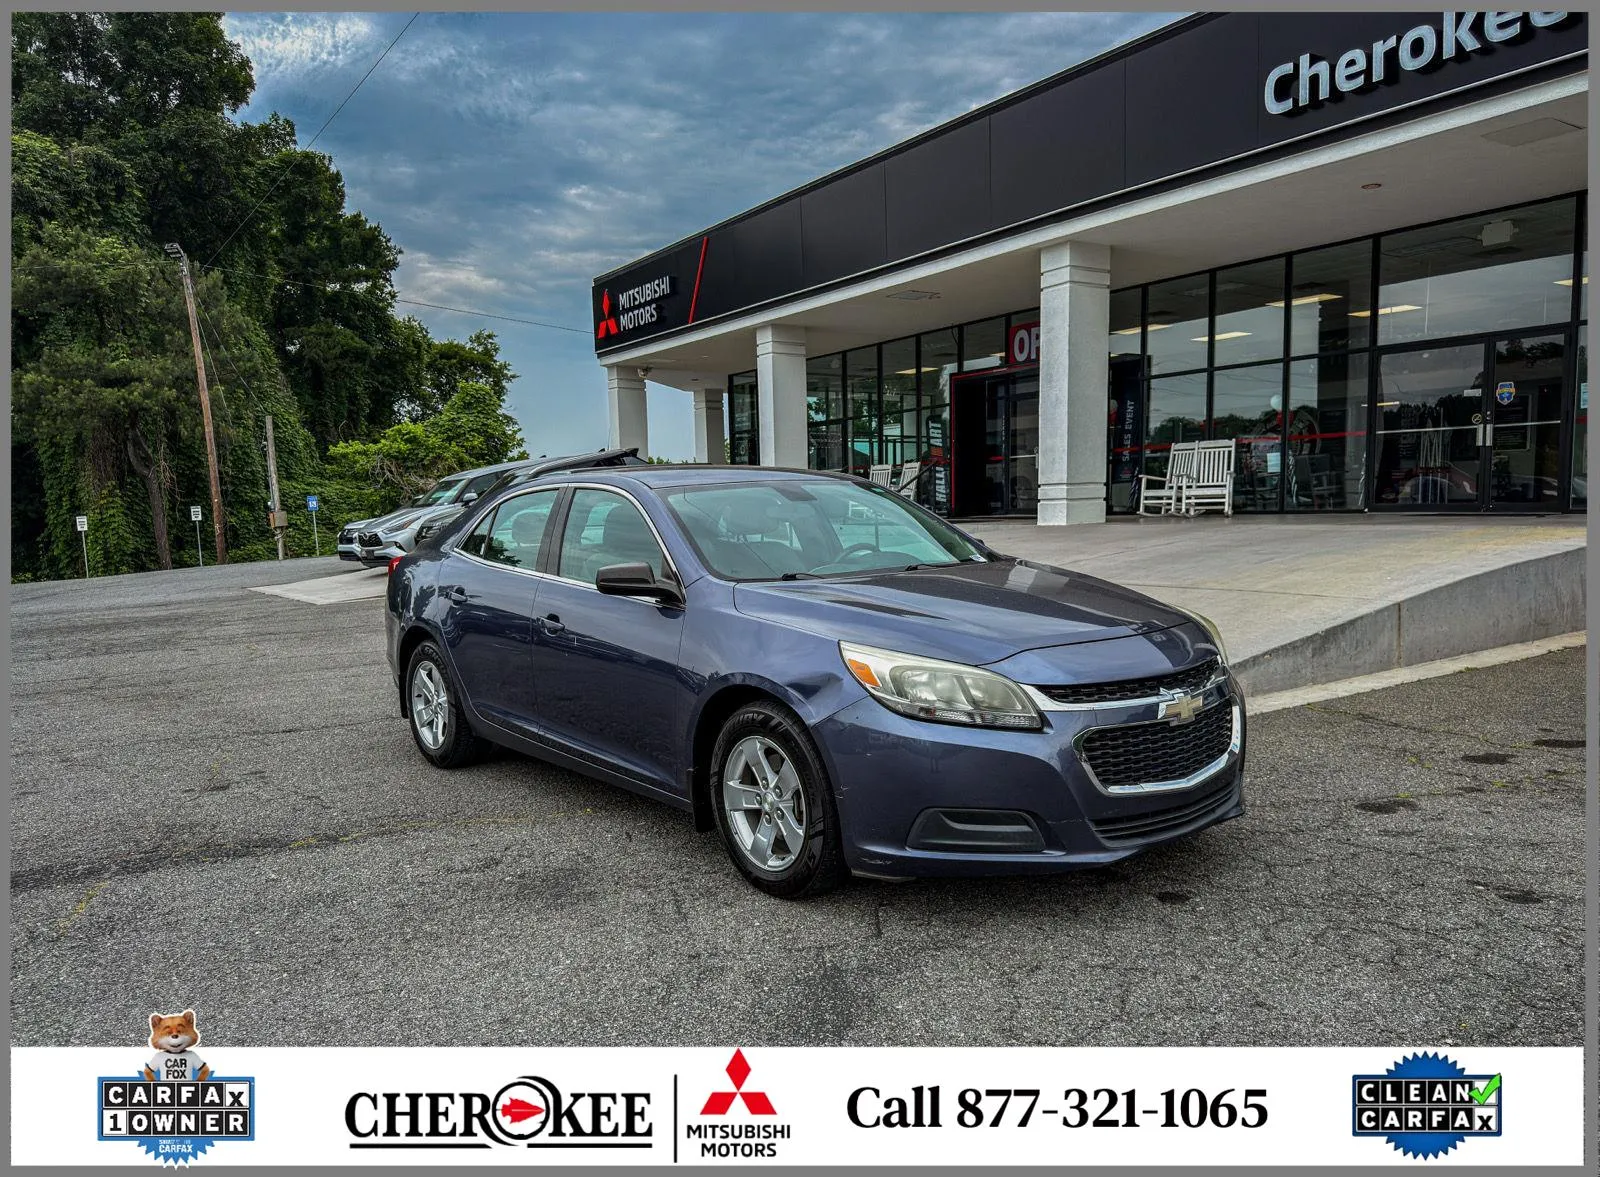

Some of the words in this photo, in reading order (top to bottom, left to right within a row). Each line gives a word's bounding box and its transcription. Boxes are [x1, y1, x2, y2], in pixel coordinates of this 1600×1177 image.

[618, 275, 671, 311] MITSUBISHI
[619, 303, 658, 332] MOTORS
[1124, 400, 1135, 430] EVENT
